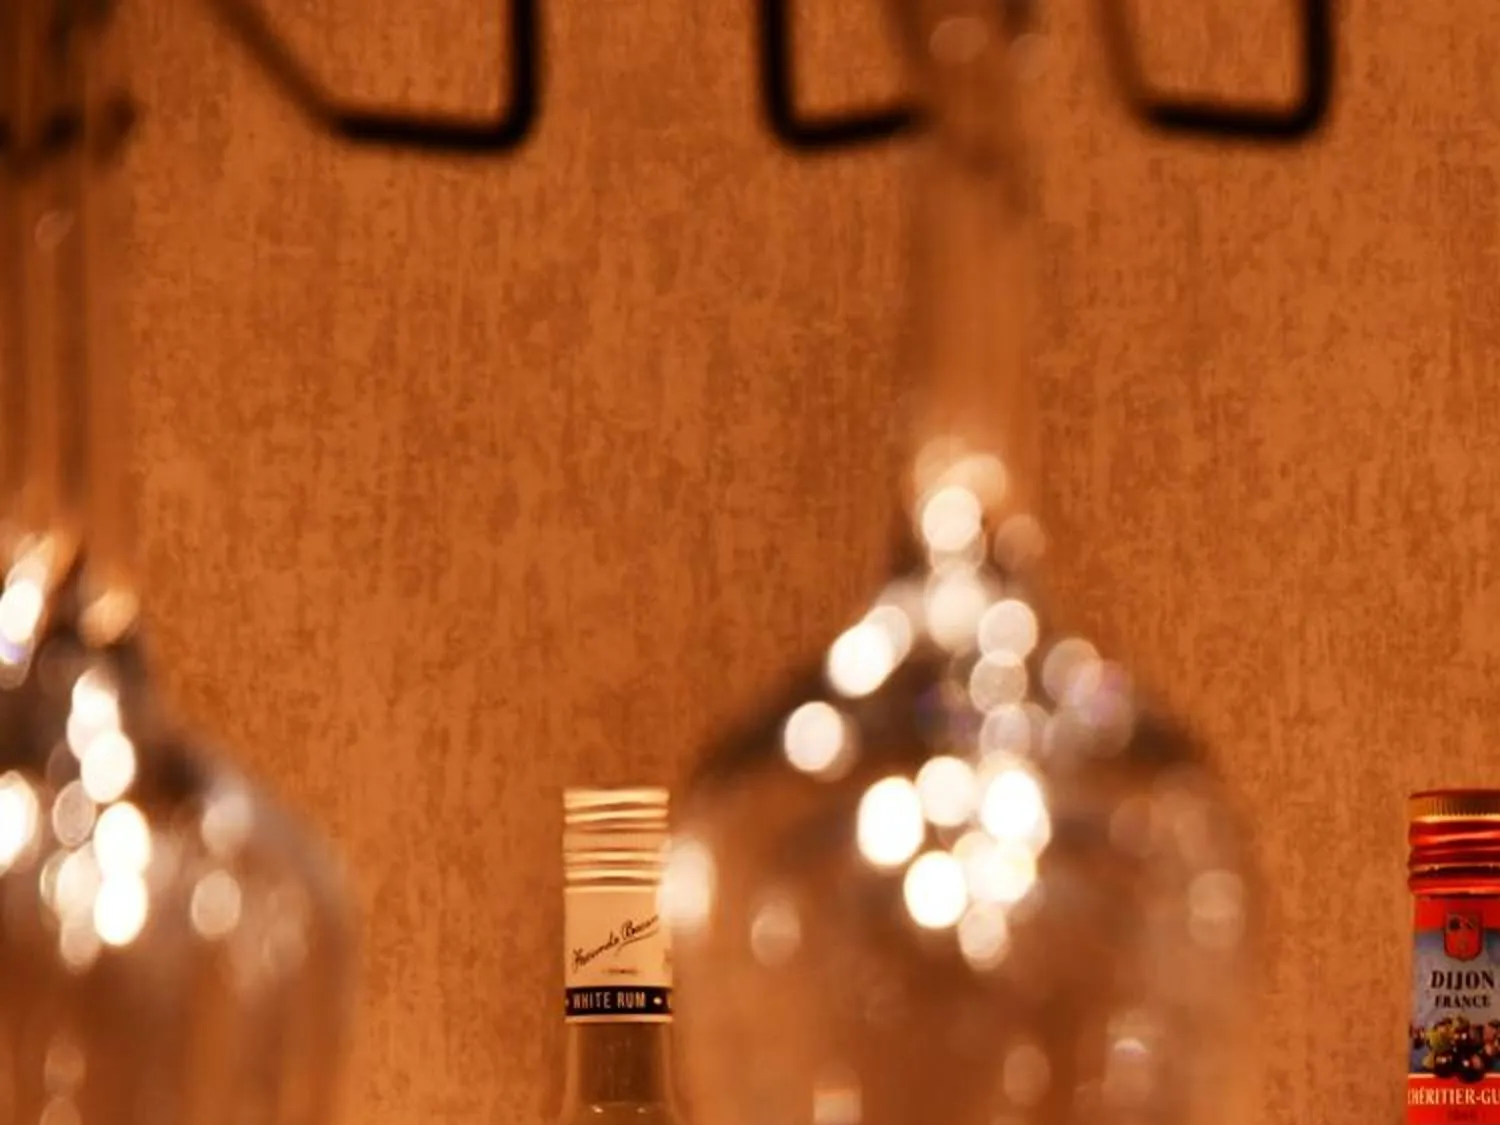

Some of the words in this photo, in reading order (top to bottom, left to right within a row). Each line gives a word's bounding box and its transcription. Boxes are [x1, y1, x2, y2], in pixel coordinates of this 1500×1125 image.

[1430, 969, 1496, 991] DIJON
[573, 992, 611, 1009] WHITE
[617, 991, 646, 1008] RUM
[1434, 994, 1492, 1009] FRANCE
